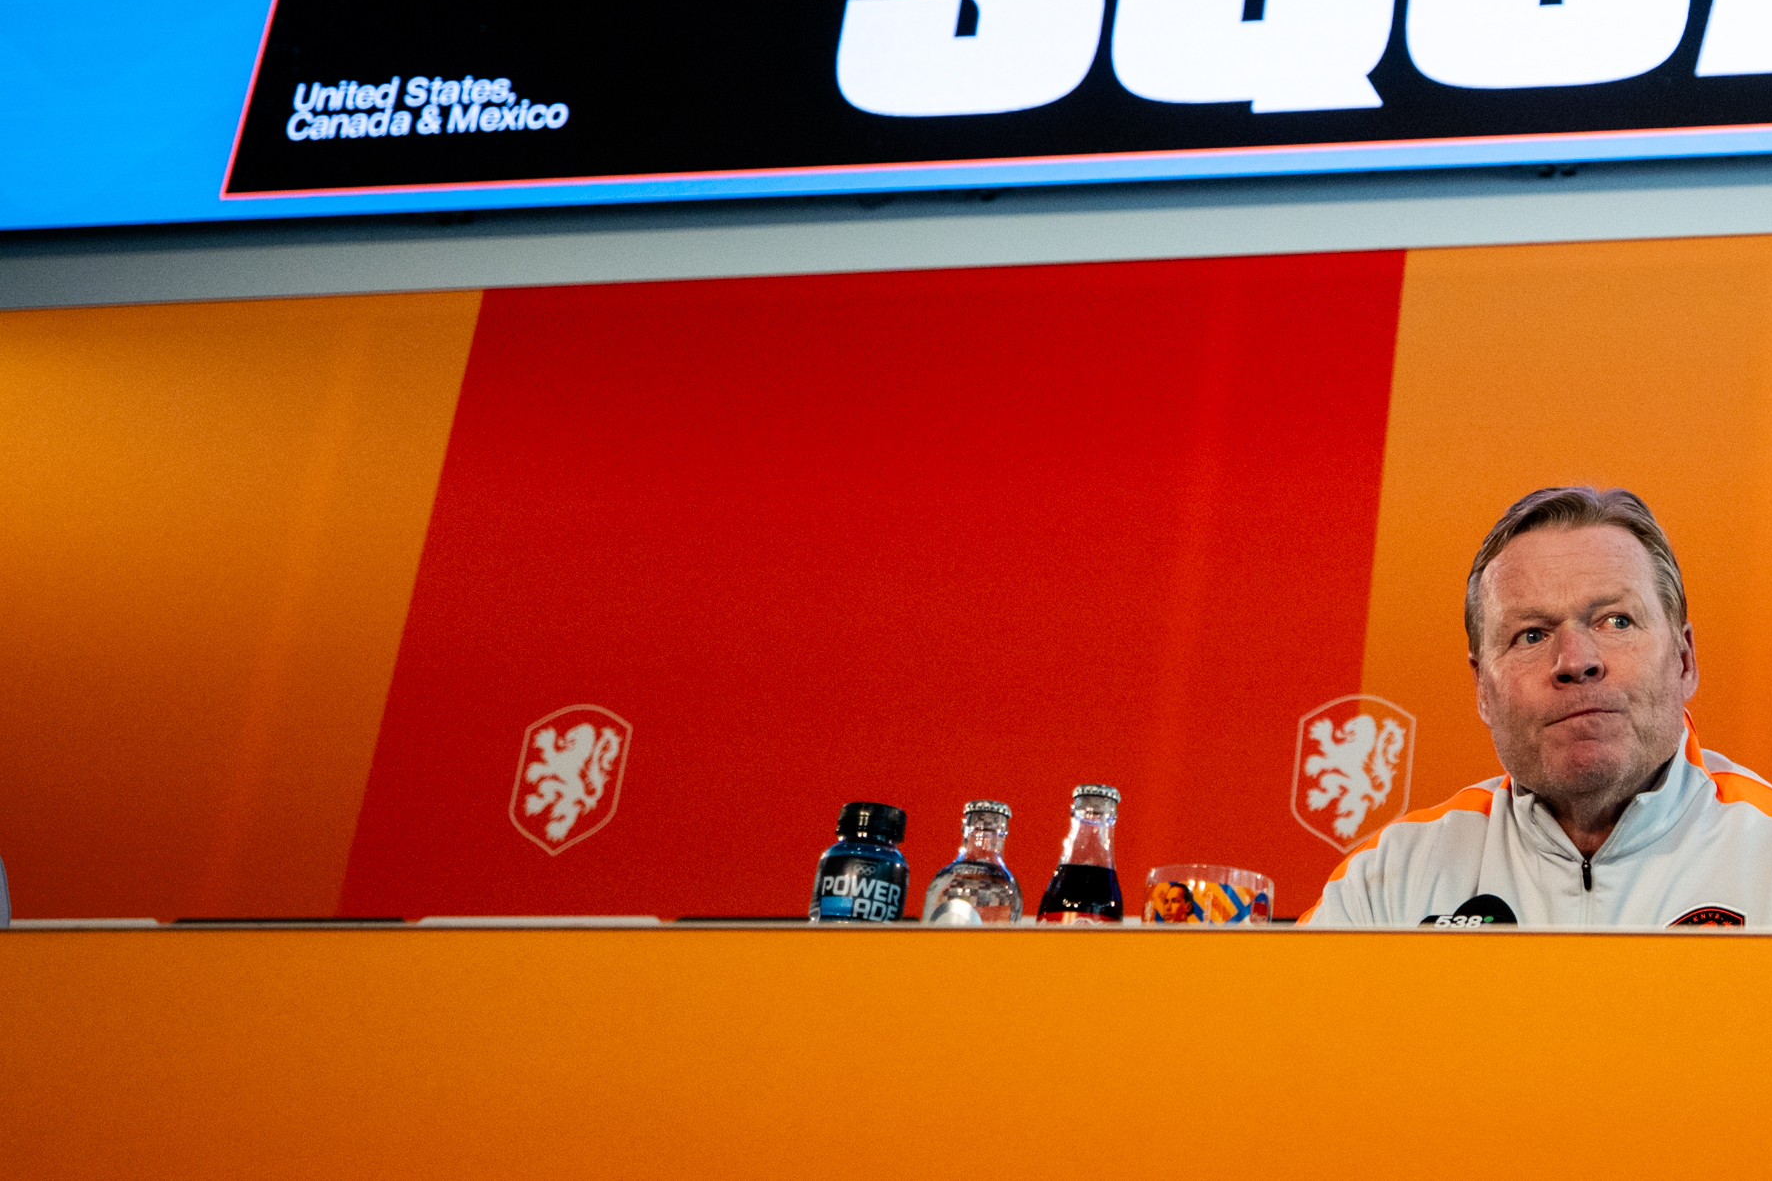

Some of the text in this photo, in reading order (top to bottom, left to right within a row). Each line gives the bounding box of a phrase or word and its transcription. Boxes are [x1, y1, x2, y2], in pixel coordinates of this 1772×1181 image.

[293, 74, 518, 112] United States,
[286, 98, 570, 142] Canada & Mexico
[821, 874, 901, 907] POWER
[852, 898, 900, 922] ADE
[1434, 915, 1483, 929] 538
[1693, 912, 1720, 922] KNVB
